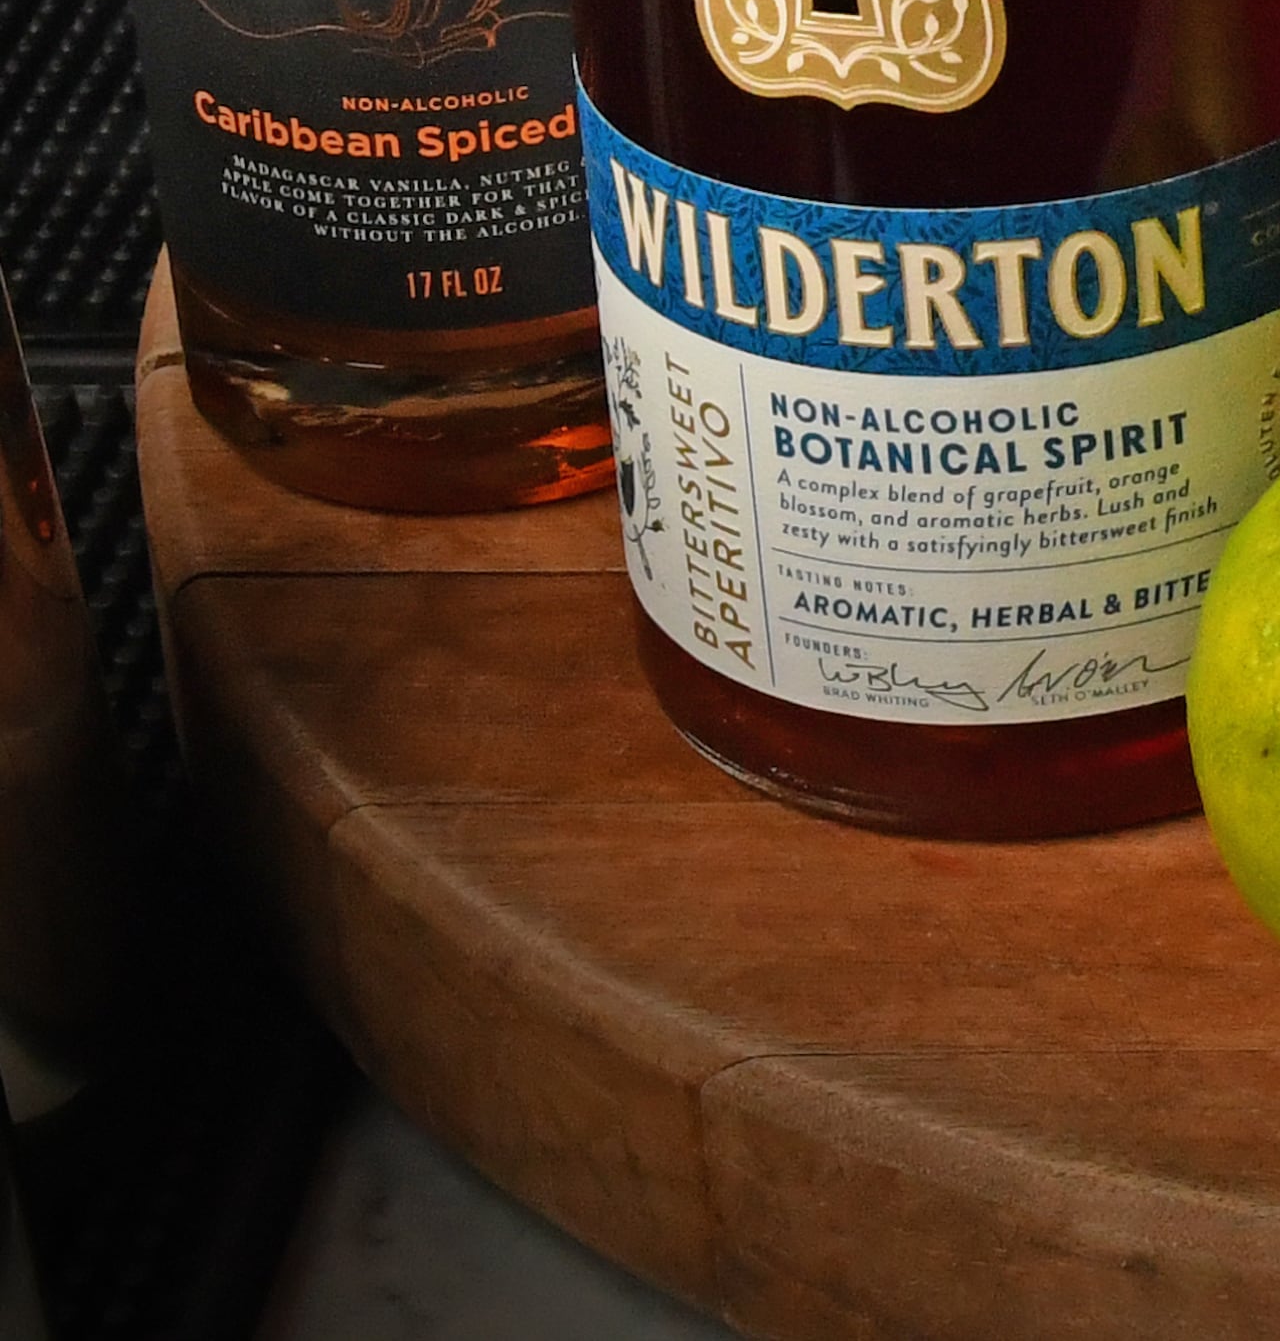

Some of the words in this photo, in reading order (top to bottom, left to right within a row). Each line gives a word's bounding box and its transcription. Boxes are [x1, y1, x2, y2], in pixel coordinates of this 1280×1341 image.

[342, 85, 529, 112] NON-ALCOHOLIC
[194, 89, 400, 158] Caribbean
[417, 104, 577, 162] Spiced
[222, 168, 272, 194] APPLE
[280, 182, 335, 205] COME
[343, 194, 461, 209] TOGETHER
[472, 188, 513, 206] FOR
[524, 175, 579, 197] THAT
[233, 155, 359, 191] MADAGASCAR
[480, 160, 570, 188] NUTMEG
[221, 182, 284, 212] FLAVOR
[293, 203, 318, 218] OF
[326, 210, 337, 221] A
[346, 212, 436, 226] CLASSIC
[447, 207, 503, 225] DARK
[515, 203, 526, 215] &
[314, 224, 413, 242] WITHOUT
[424, 228, 467, 241] THE
[610, 157, 1205, 350] WILDERTON
[406, 270, 431, 299] 17
[442, 270, 467, 297] FL
[475, 265, 503, 294] OZ
[770, 392, 1080, 434] NON-ALCOHOLIC
[773, 426, 1027, 475] BOTANICAL
[1044, 412, 1188, 470] SPIRIT
[664, 352, 719, 649] BITTERSWEET
[777, 468, 791, 487] A
[798, 477, 879, 507] complex
[888, 484, 944, 504] blend
[954, 485, 977, 510] of
[984, 476, 1101, 509] grapefruit,
[1108, 462, 1179, 489] orange
[780, 494, 863, 526] blossom,
[871, 506, 908, 527] and
[917, 511, 1014, 529] aromatic
[1023, 503, 1089, 526] herbs.
[1098, 492, 1145, 517] Lush
[1153, 479, 1190, 505] and
[699, 401, 755, 671] APERITIVO
[781, 523, 829, 548] zesty
[838, 530, 879, 550] with
[887, 540, 899, 551] a
[907, 533, 1032, 560] satisfyingly
[1039, 516, 1157, 550] bittersweet
[1164, 496, 1218, 533] finish
[778, 564, 842, 588] TASTING
[853, 579, 914, 597] NOTES:
[793, 591, 958, 633] AROMATIC,
[970, 604, 1093, 629] HERBAL
[1103, 593, 1122, 615] &
[1134, 568, 1211, 611] BITTE
[785, 632, 869, 660] FOUNDERS:
[823, 685, 860, 701] BRAD
[865, 692, 930, 708] WHITING
[1031, 693, 1068, 706] SETH
[1075, 680, 1149, 701] O'MALLEY
